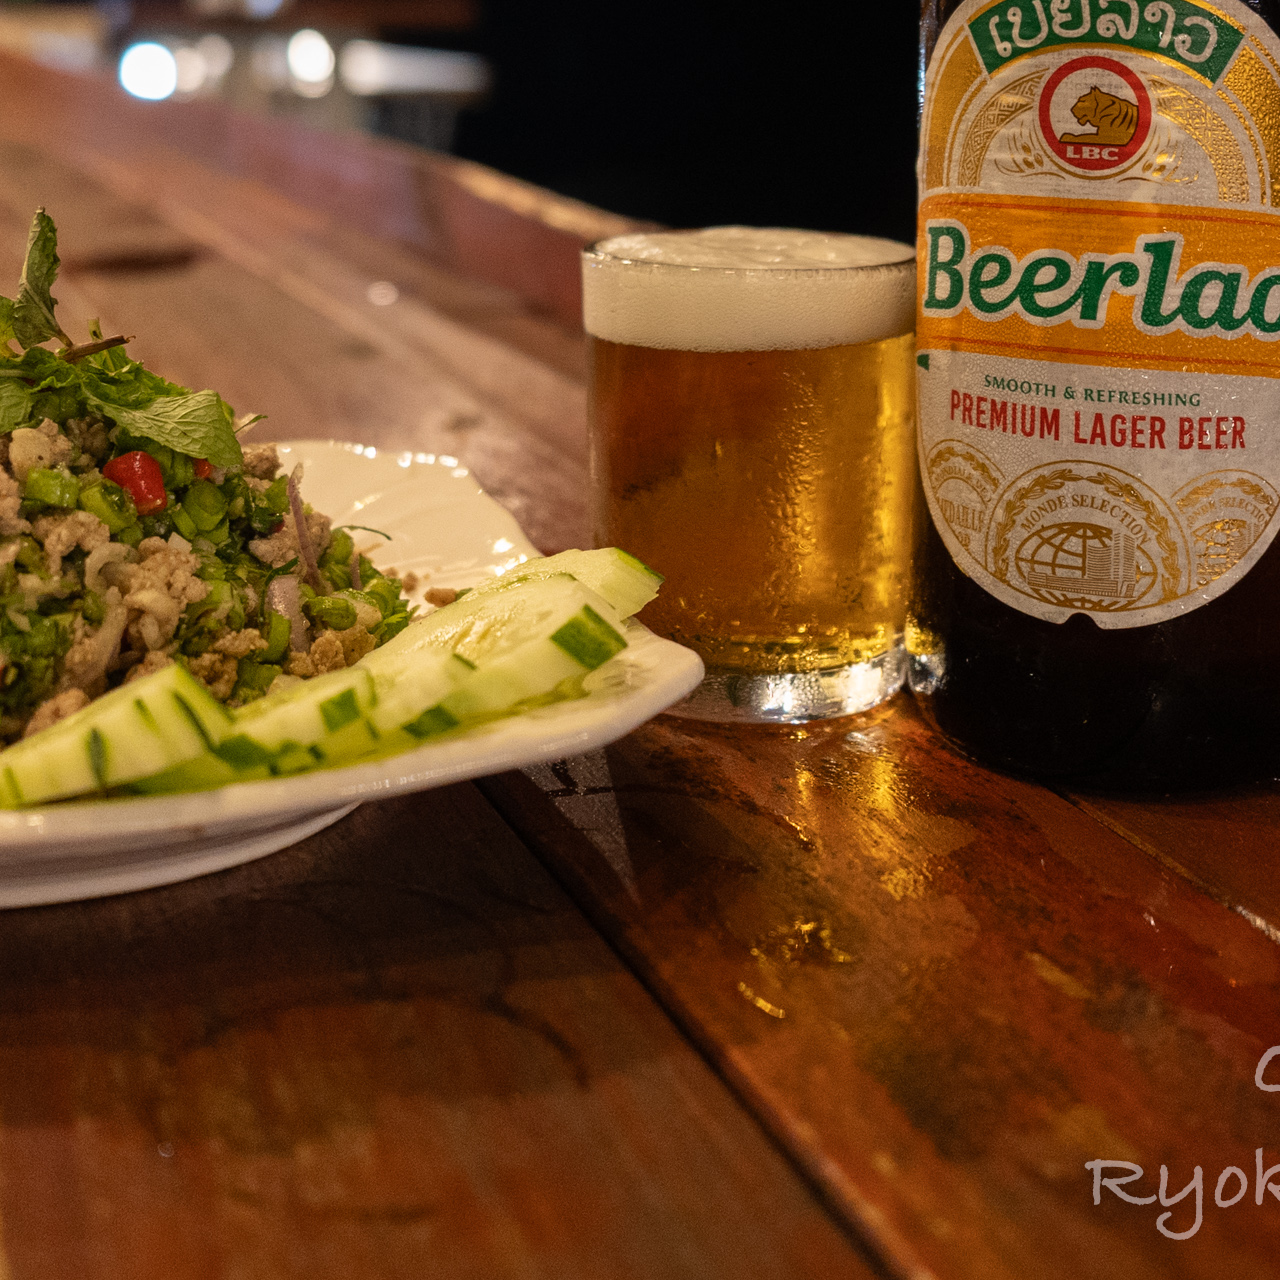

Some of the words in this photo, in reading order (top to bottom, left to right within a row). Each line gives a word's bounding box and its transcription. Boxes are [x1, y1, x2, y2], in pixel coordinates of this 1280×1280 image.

[1066, 145, 1119, 162] LBC
[983, 374, 1056, 398] SMOOTH
[1063, 386, 1076, 400] &
[1083, 388, 1201, 407] REFRESHING
[950, 389, 1060, 441] PREMIUM
[1074, 410, 1167, 449] LAGER
[1178, 416, 1246, 450] BEER
[1021, 495, 1070, 534] MONDE
[1072, 494, 1152, 547] SELECTION
